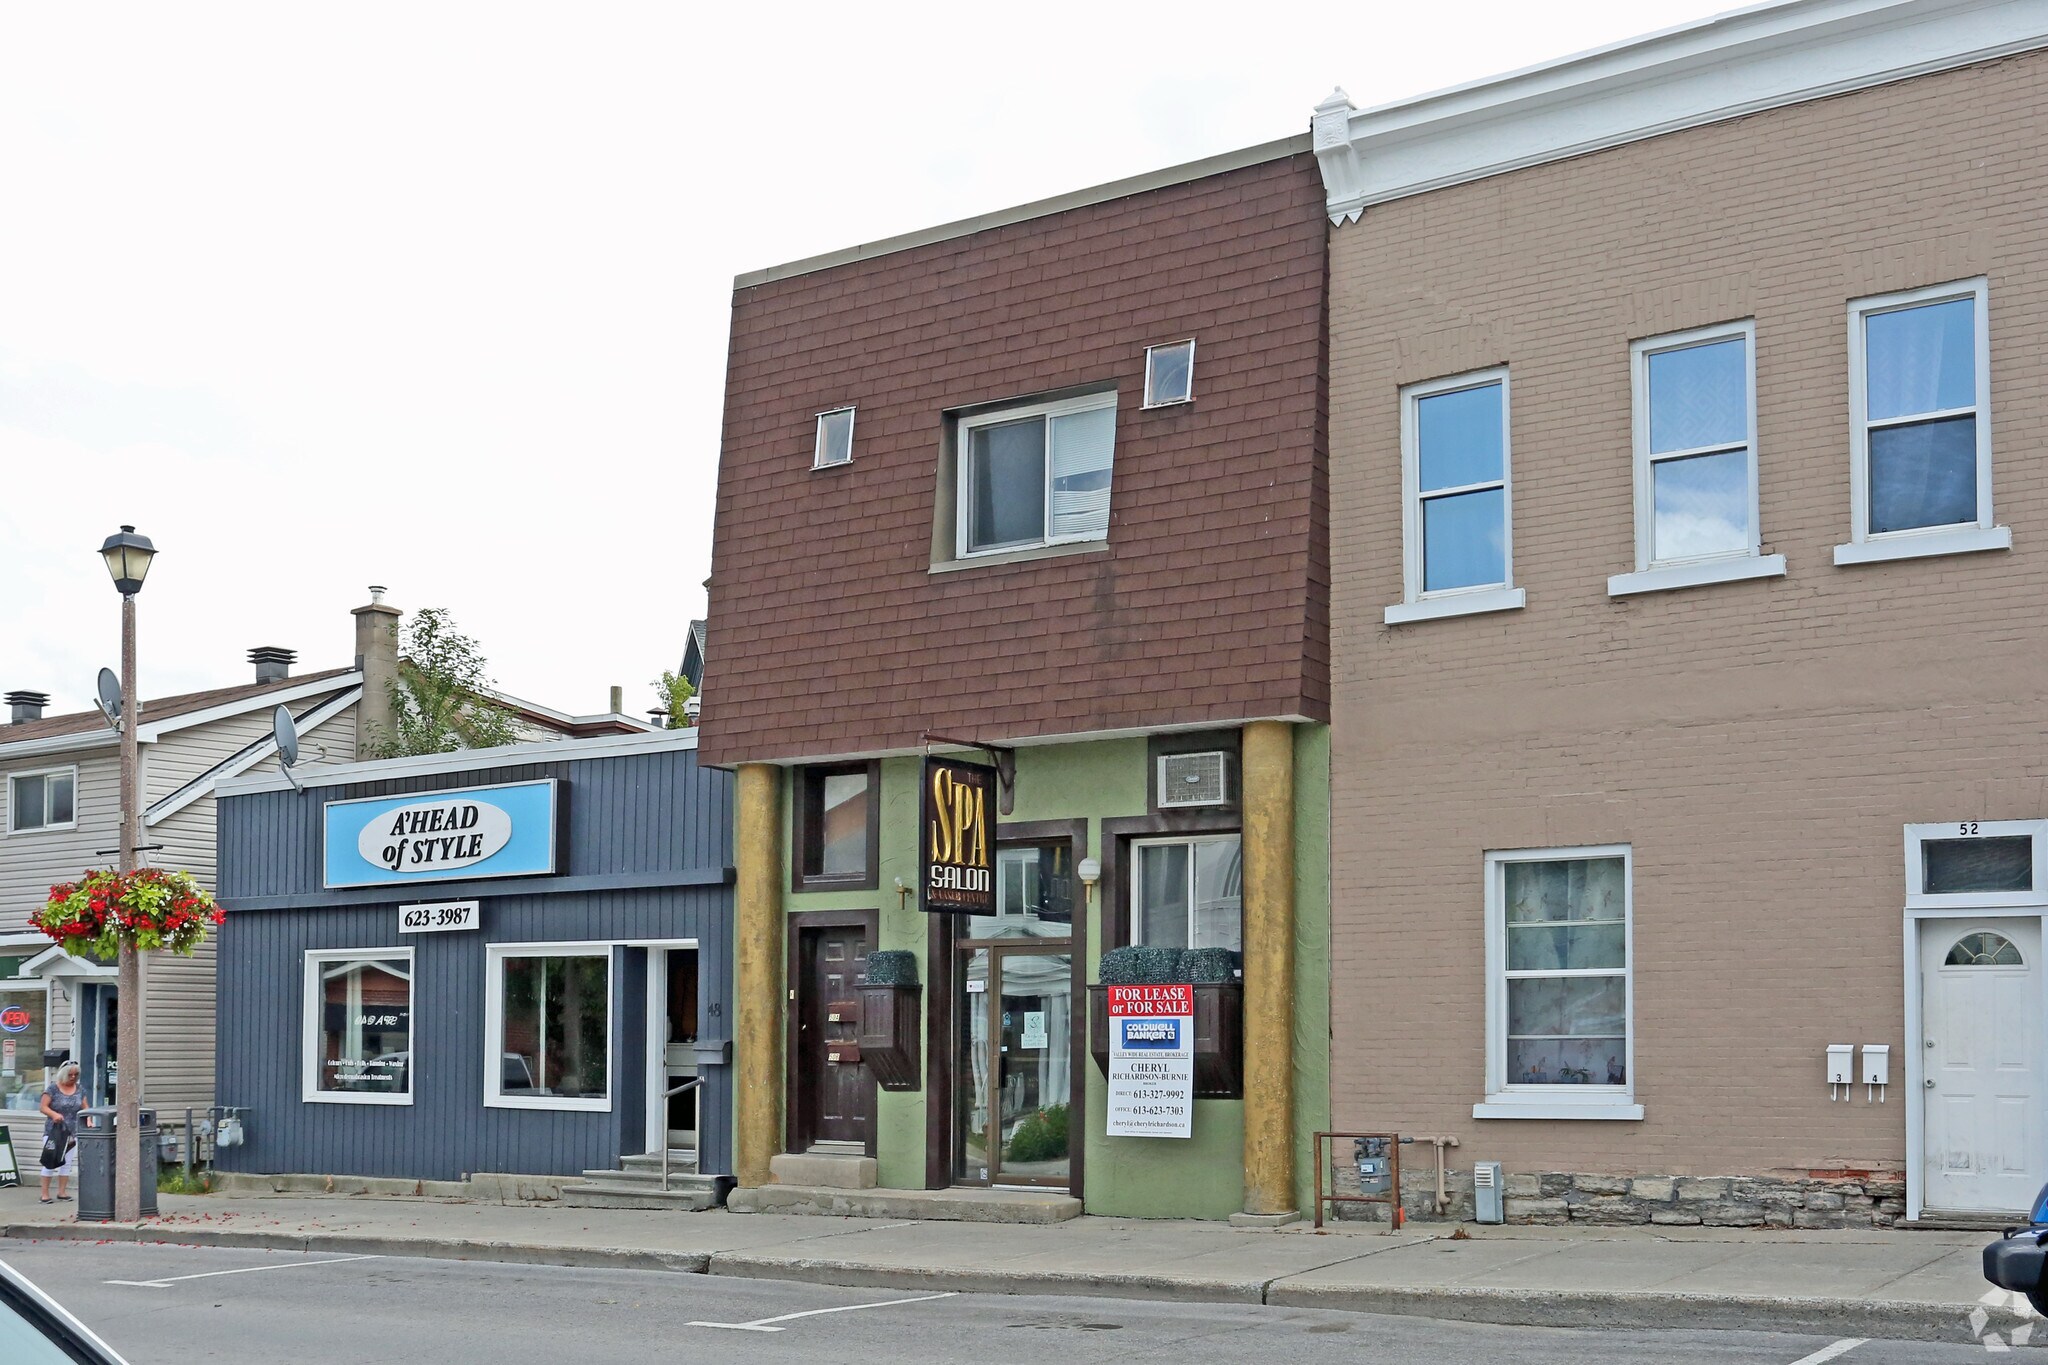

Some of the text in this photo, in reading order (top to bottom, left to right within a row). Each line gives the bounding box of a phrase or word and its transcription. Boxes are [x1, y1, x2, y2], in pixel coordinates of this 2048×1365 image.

[967, 772, 982, 784] THE
[389, 805, 479, 836] A'HEAD
[932, 767, 990, 868] SPA
[1960, 823, 1979, 835] 52
[382, 833, 484, 871] of STYLE
[931, 865, 990, 892] SALON
[404, 907, 471, 928] 623-3987
[1115, 987, 1186, 1000] FOR LEASE
[708, 1003, 722, 1017] 48
[1112, 1000, 1190, 1014] or FOR SALE
[1, 1011, 30, 1026] OPEN
[1126, 1023, 1176, 1032] COLDWELL
[1127, 1031, 1166, 1041] BANKER
[1130, 1063, 1170, 1072] CHERYL
[1112, 1073, 1189, 1081] RICHARDSON-BURNIE
[1836, 1073, 1842, 1082] 3
[1872, 1074, 1878, 1082] 4
[1133, 1089, 1185, 1100] 613-327-9992
[1132, 1105, 1184, 1116] 613-623-7303
